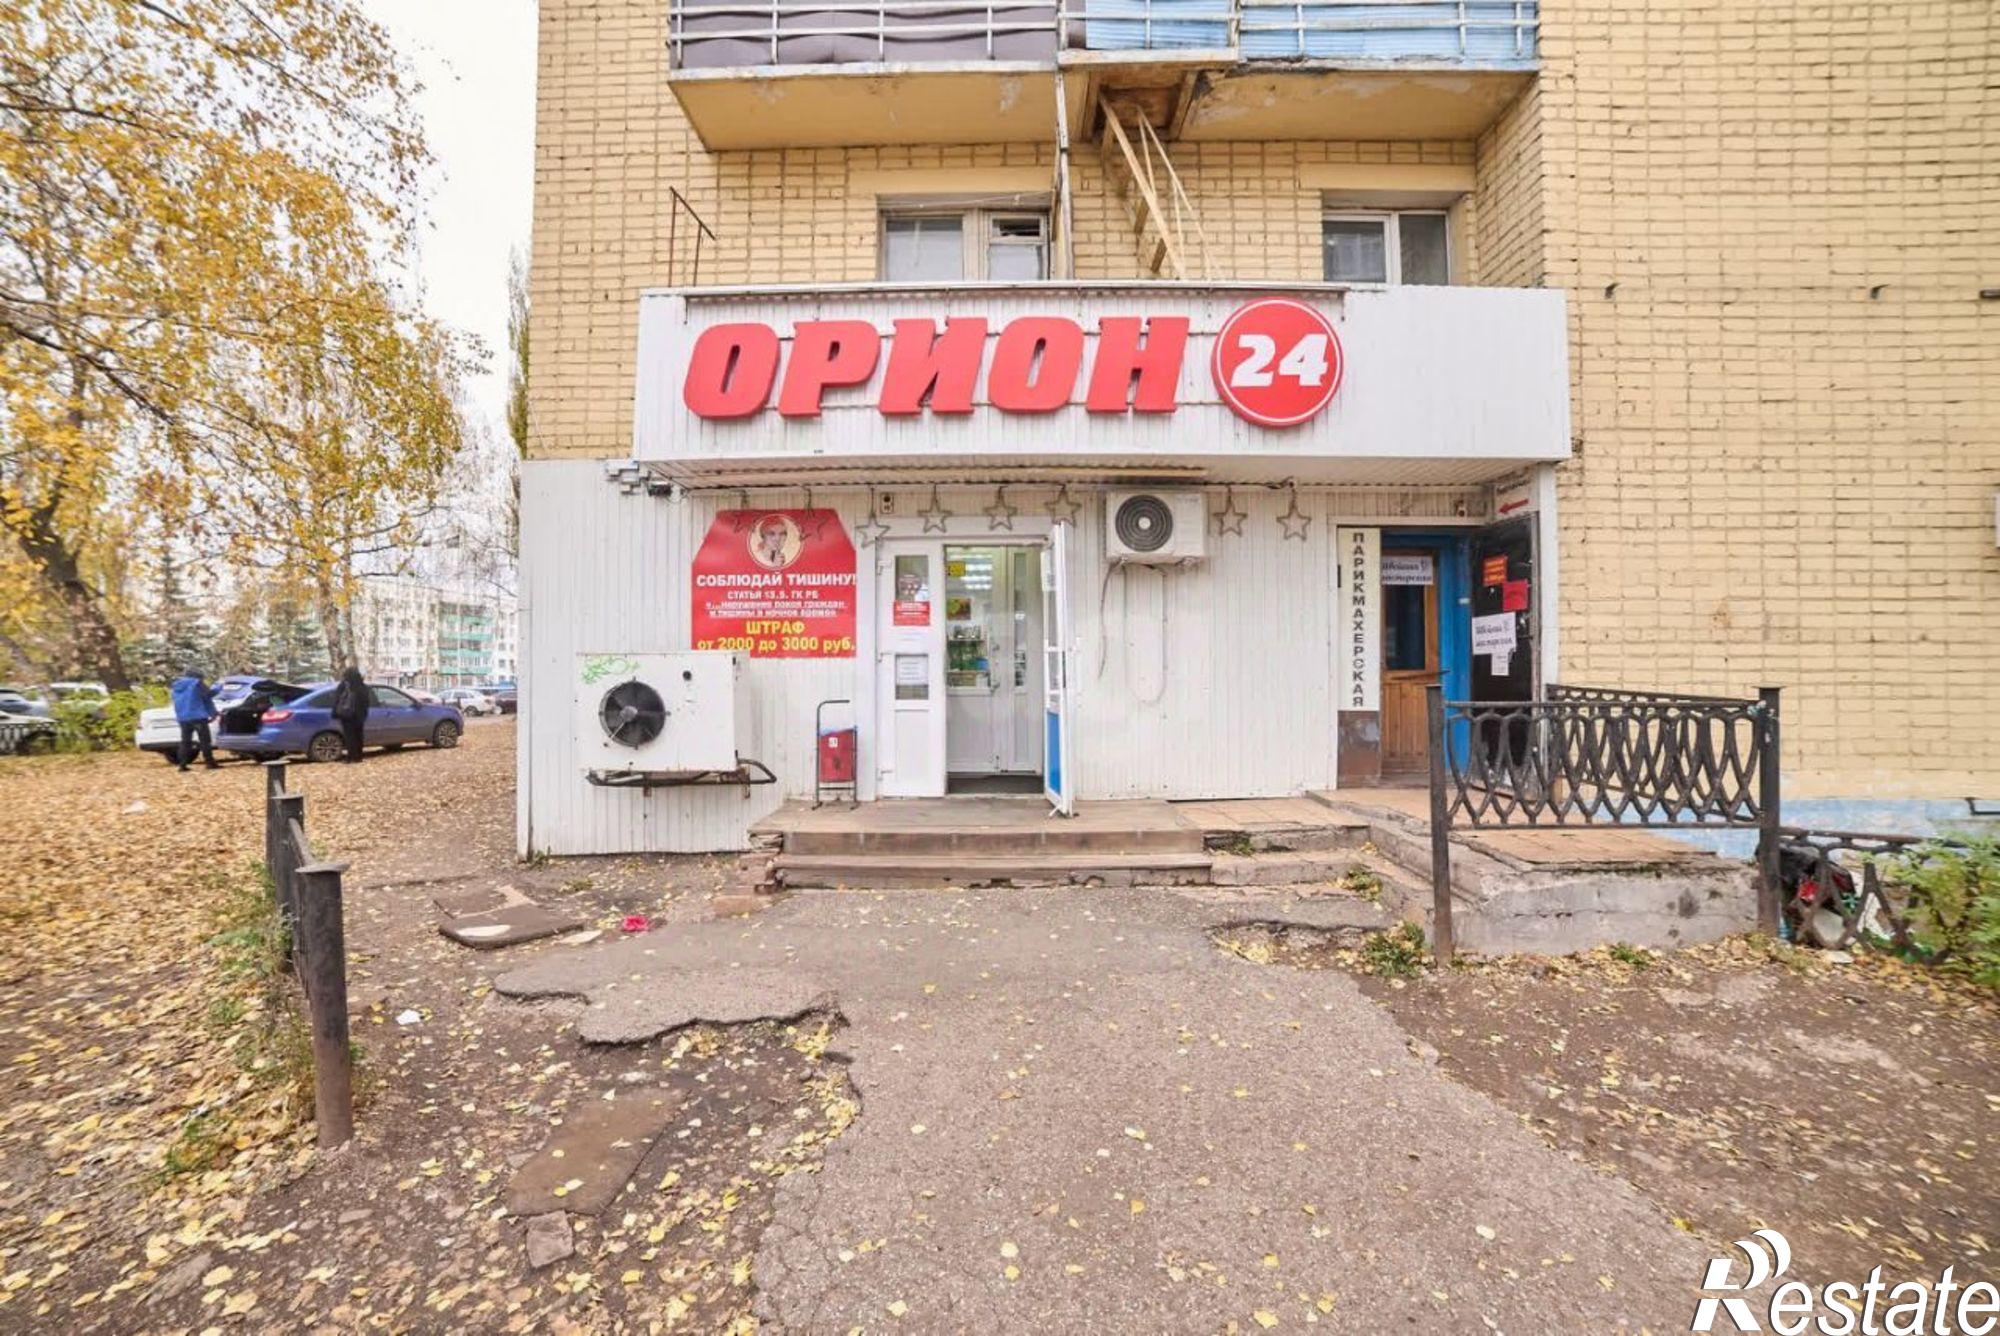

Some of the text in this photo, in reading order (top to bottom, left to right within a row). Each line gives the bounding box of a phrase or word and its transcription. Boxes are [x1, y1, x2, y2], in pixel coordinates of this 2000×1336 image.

[682, 315, 1190, 418] ОРИОН
[1230, 333, 1328, 388] 24
[697, 572, 782, 587] СОБЛЮДАЙ
[727, 590, 762, 600] СТАТЬЯ
[746, 621, 805, 634] ШТРАФ
[1352, 532, 1366, 707] ПАРИКМАХЕРСКАЯ
[697, 637, 854, 653] от 2000 до 3000 руб.
